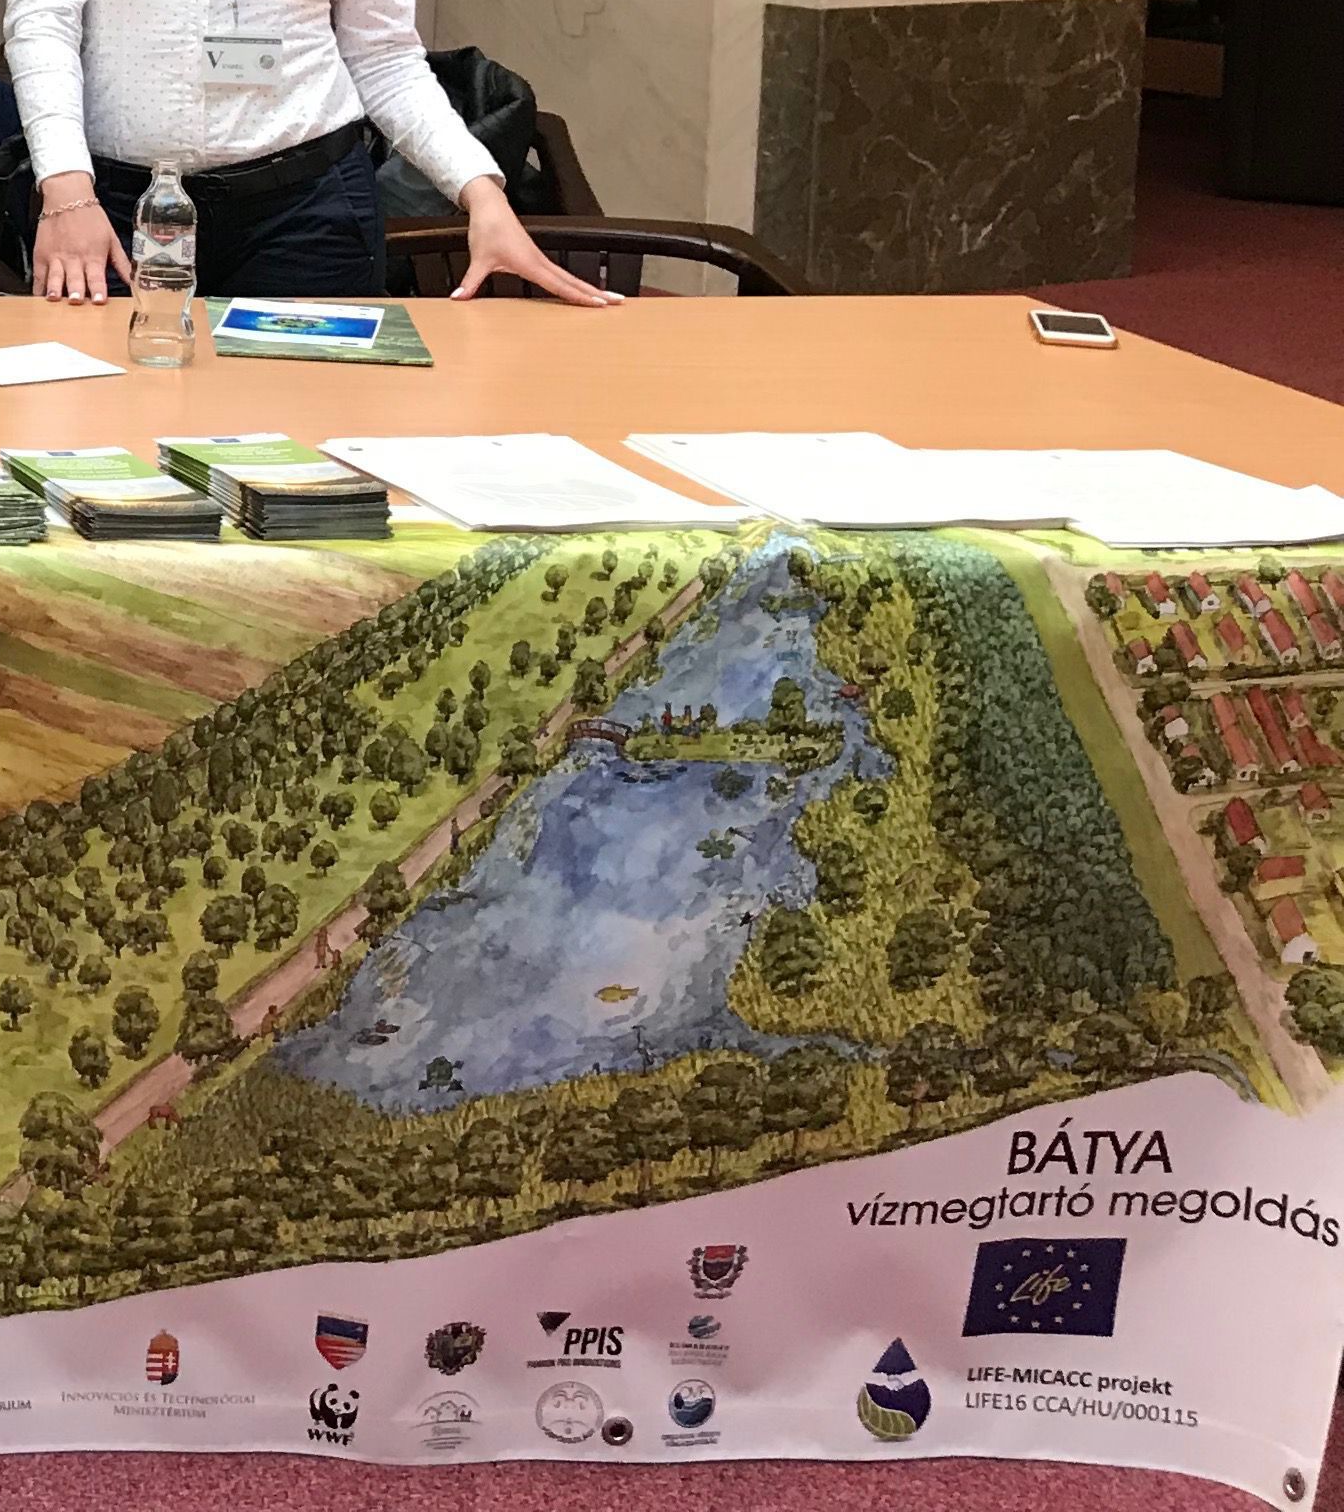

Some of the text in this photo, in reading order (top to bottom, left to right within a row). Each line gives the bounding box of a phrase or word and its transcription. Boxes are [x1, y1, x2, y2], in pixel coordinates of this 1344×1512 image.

[1007, 1117, 1172, 1175] BÁTYA
[847, 1185, 1340, 1247] vízmegtartó megoldás
[1010, 1264, 1071, 1305] Life
[564, 1326, 625, 1356] PPIS
[967, 1367, 1172, 1395] LIFE-MICACC projekt
[966, 1392, 1197, 1423] LIFE16 CCA/HU/000115
[307, 1426, 354, 1446] WWF
